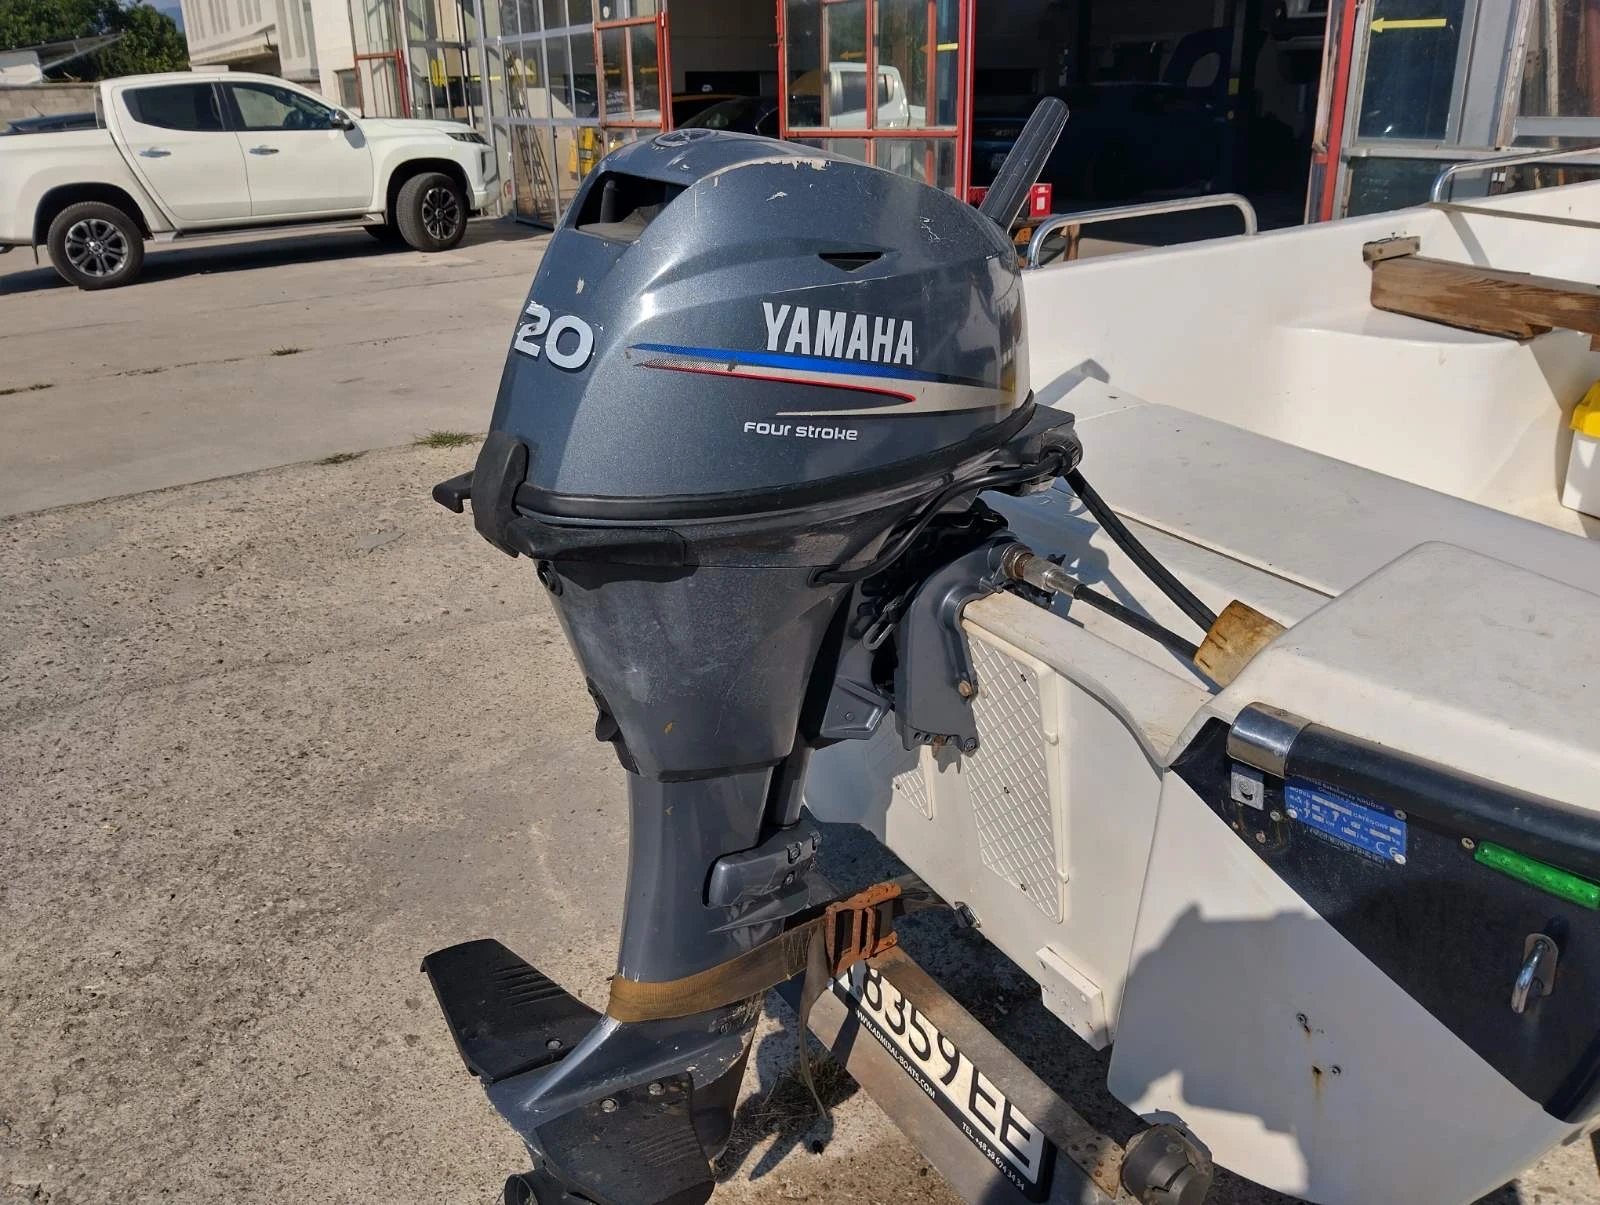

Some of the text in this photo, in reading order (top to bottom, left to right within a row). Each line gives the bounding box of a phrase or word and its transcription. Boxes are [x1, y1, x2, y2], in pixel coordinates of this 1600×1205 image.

[513, 300, 594, 369] 20
[763, 302, 913, 366] YAMAHA
[855, 1008, 936, 1100] WWW.ADMIRAL-BOATS.COM
